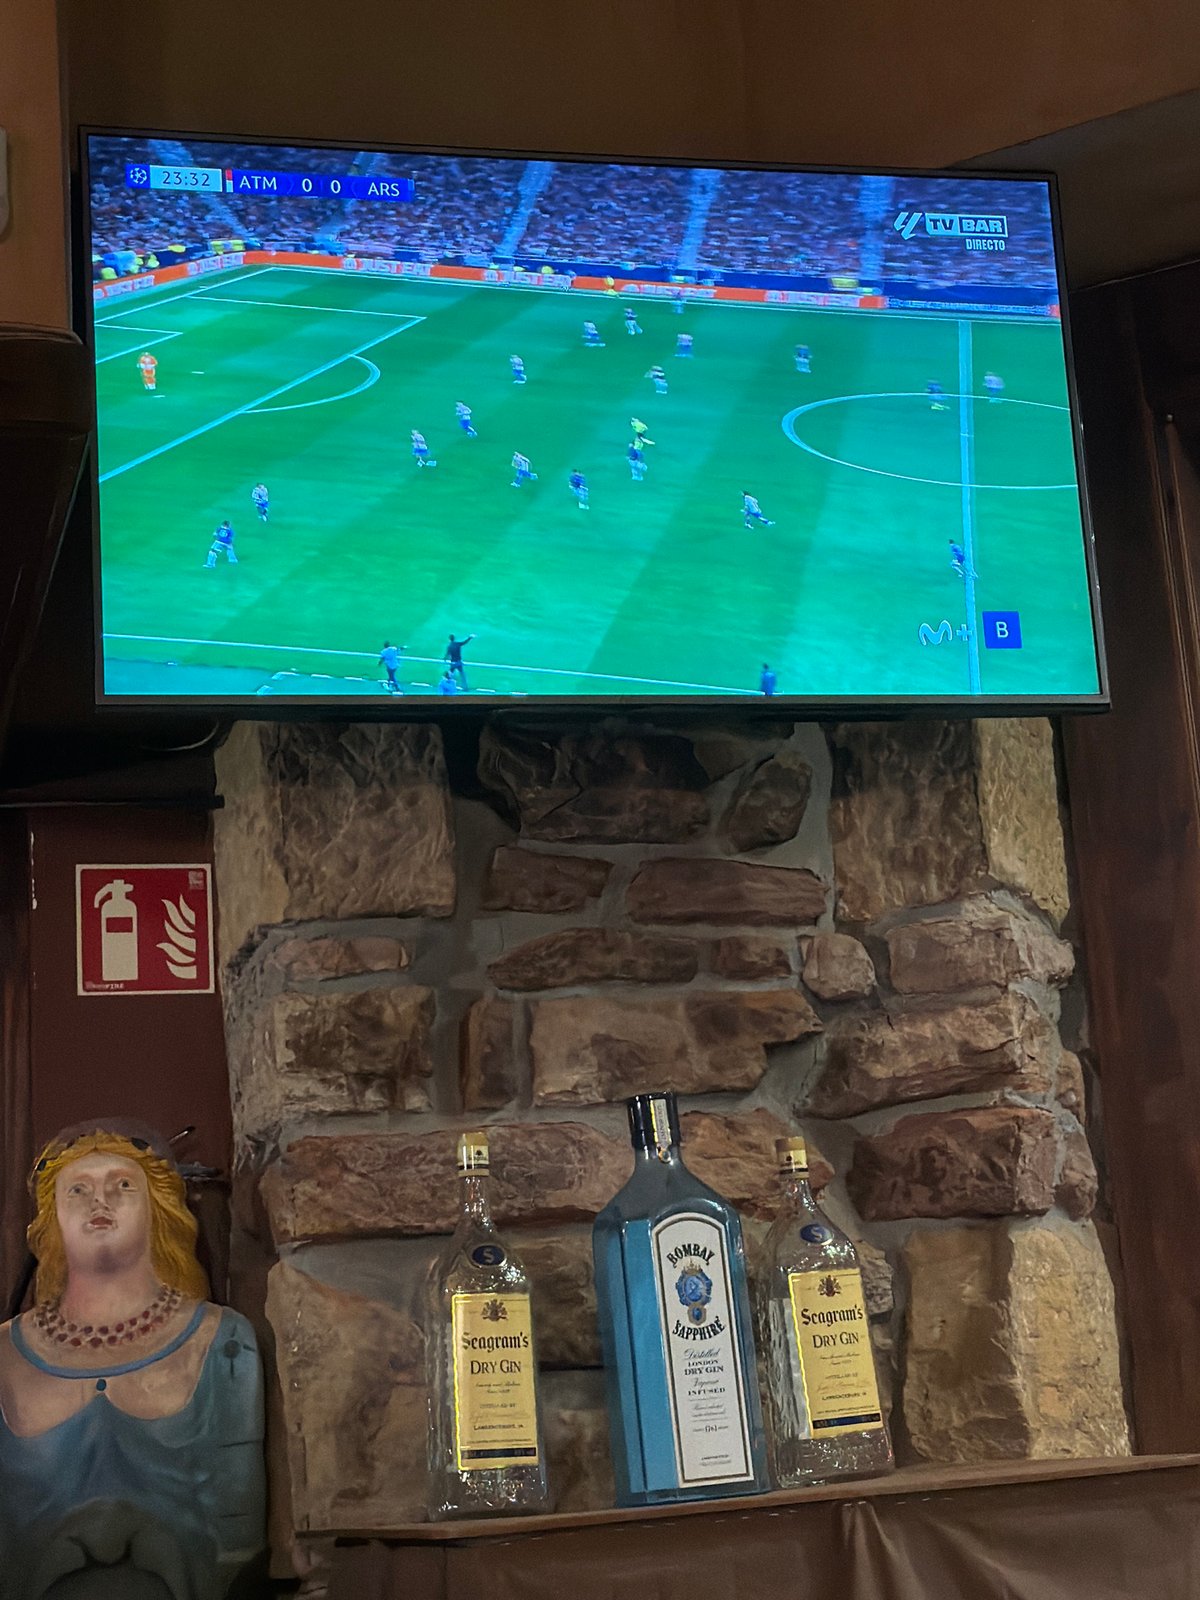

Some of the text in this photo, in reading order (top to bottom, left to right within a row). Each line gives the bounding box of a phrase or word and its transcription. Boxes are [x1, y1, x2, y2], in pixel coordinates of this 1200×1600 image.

[162, 171, 211, 187] 23:32
[239, 175, 400, 197] ATM 0 0 ARS
[928, 218, 1003, 233] TV BAR
[965, 238, 1006, 251] DIRECTO
[995, 621, 1009, 638] B
[666, 1243, 715, 1268] BOMBAY
[800, 1304, 864, 1327] Seagram's
[672, 1315, 725, 1341] SAPPHIRE
[461, 1331, 529, 1353] Seagram's
[812, 1331, 859, 1349] DRY GIN
[470, 1359, 521, 1374] DRY GIN
[684, 1365, 724, 1376] DRY GIN
[687, 1359, 719, 1368] LONDON
